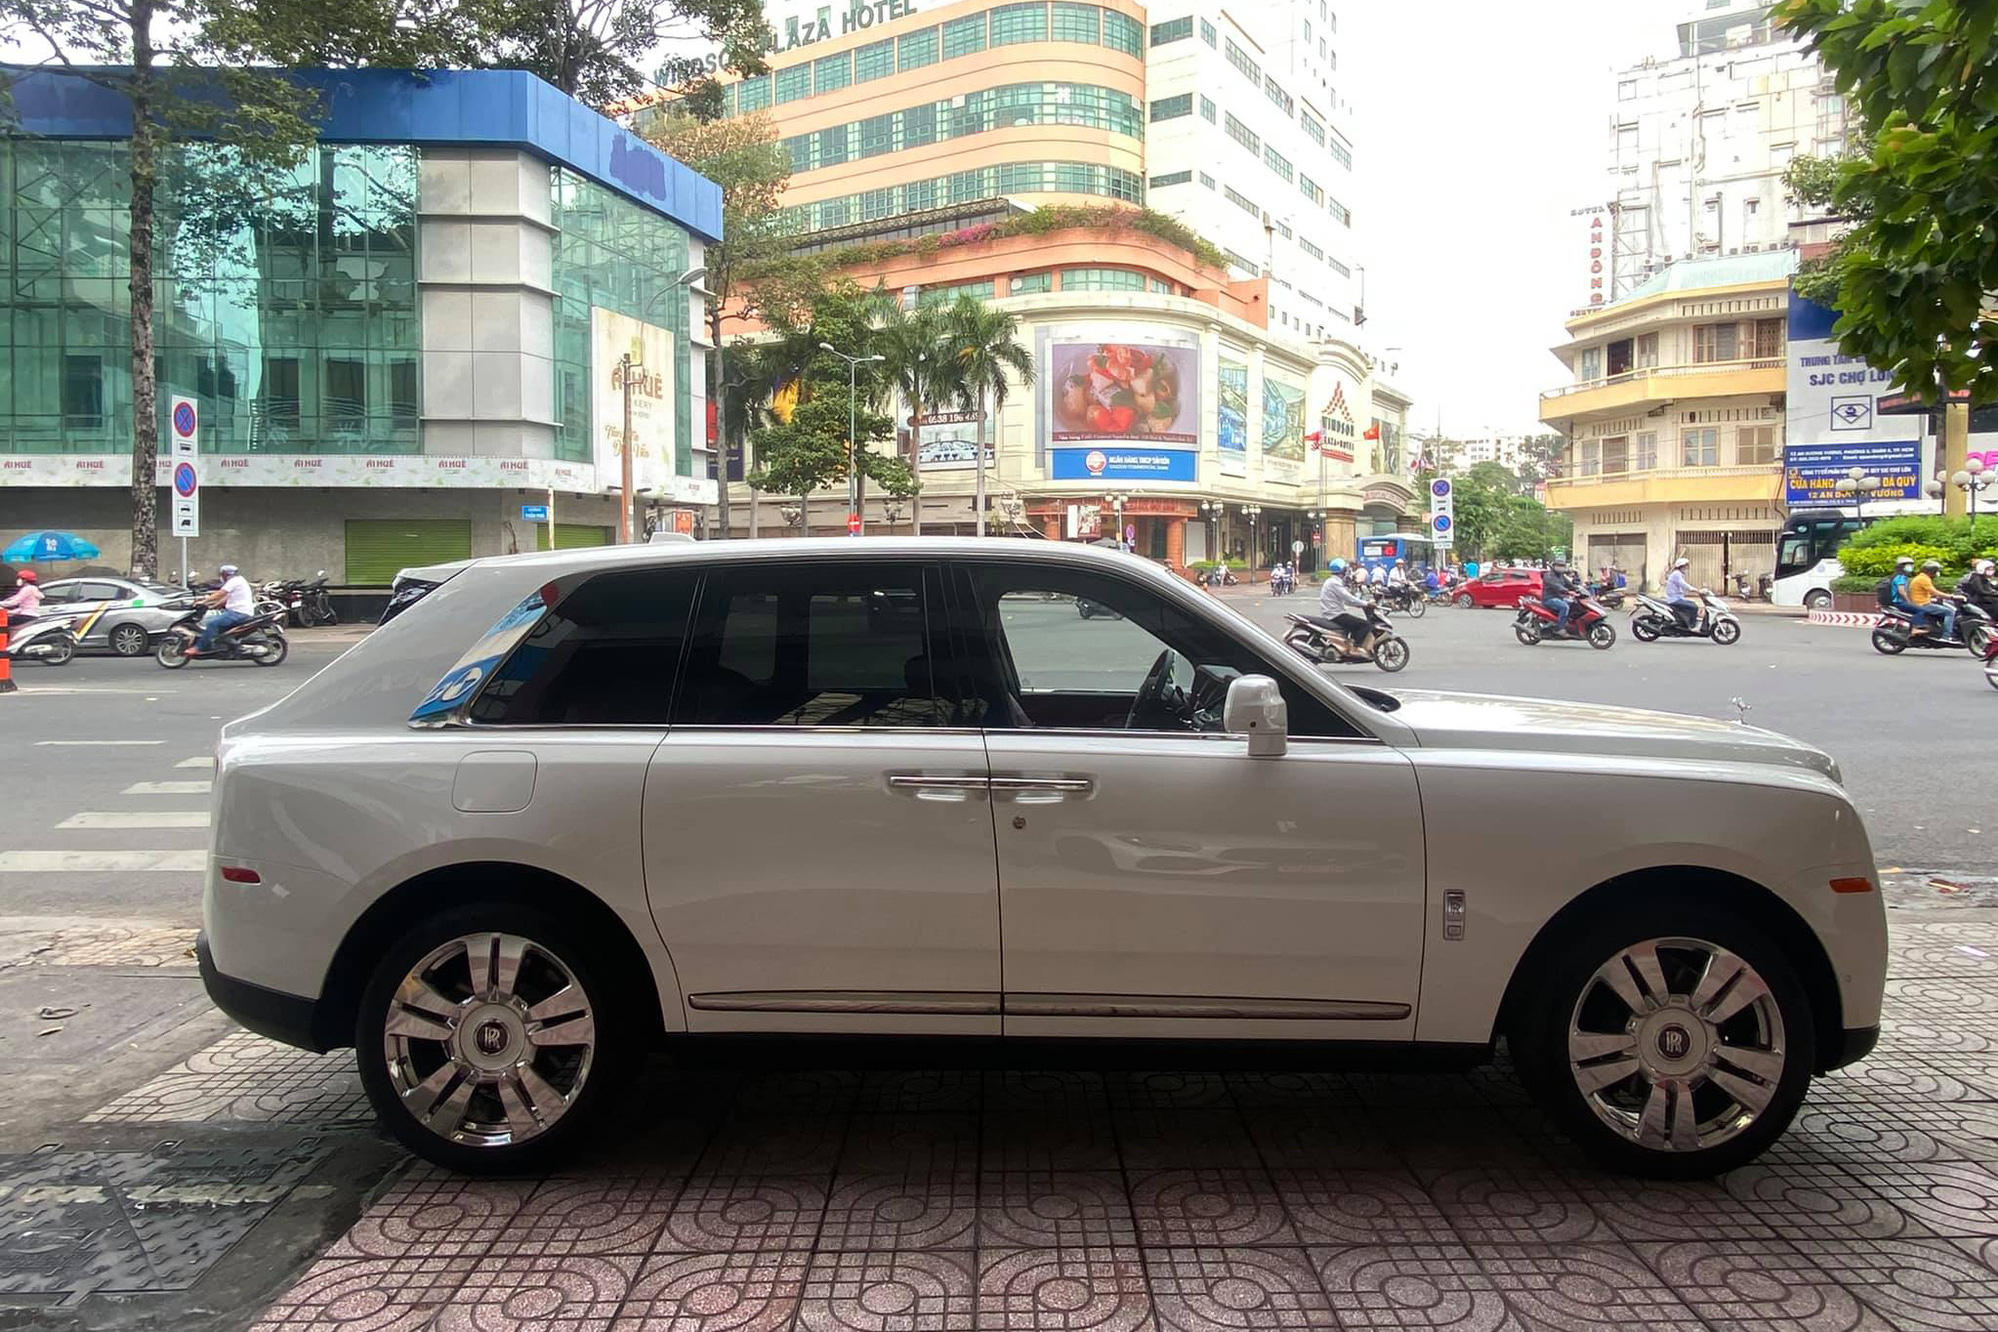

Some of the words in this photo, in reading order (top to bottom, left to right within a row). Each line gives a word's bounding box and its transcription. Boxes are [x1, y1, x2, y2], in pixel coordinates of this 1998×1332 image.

[764, 17, 831, 55] LAZA
[842, 0, 917, 34] HOTEL
[1809, 373, 1835, 386] SJC
